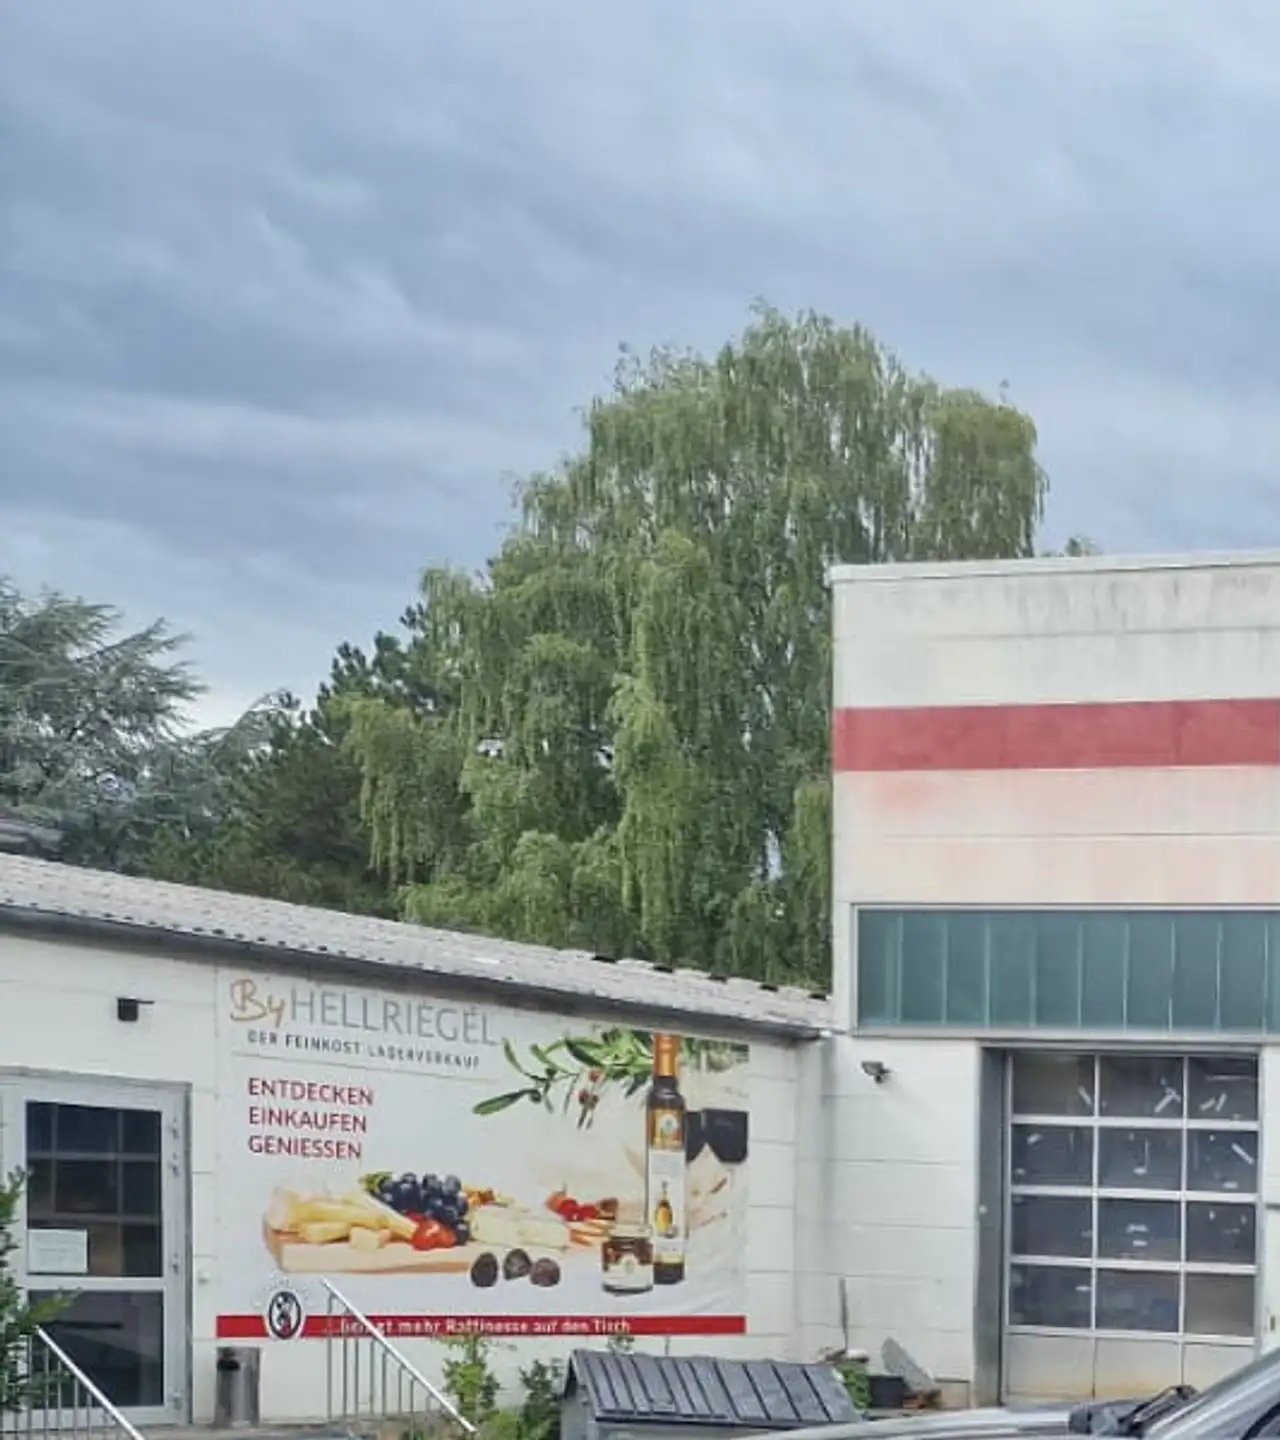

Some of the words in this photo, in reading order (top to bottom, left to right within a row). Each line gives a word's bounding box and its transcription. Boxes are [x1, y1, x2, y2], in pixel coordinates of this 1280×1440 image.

[291, 987, 500, 1047] HELLRIEGEL
[285, 1033, 361, 1056] FEINKOST
[248, 1077, 374, 1106] ENTDECKEN
[248, 1105, 367, 1133] EINKAUFEN
[248, 1134, 361, 1160] GENIESSEN
[398, 1317, 441, 1333] mehr
[446, 1317, 528, 1333] Raffinesse
[532, 1318, 558, 1333] auf
[562, 1317, 589, 1333] den
[591, 1316, 631, 1333] Tisch
